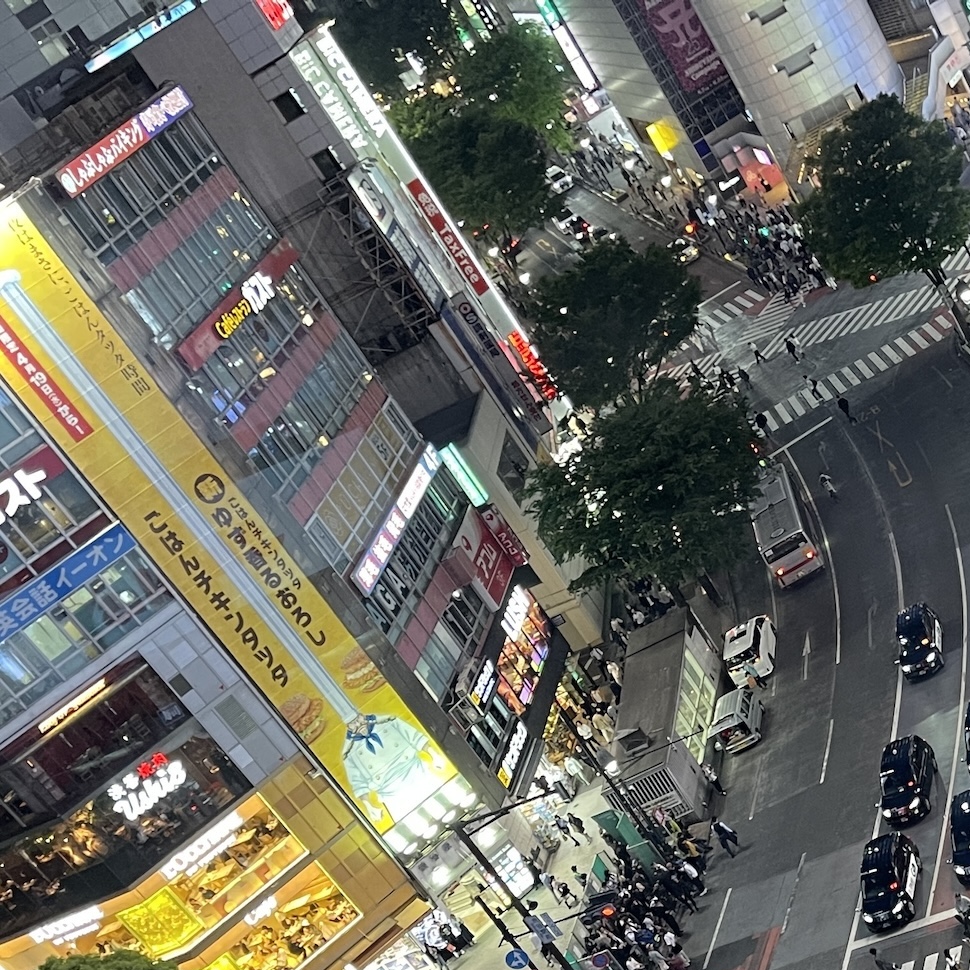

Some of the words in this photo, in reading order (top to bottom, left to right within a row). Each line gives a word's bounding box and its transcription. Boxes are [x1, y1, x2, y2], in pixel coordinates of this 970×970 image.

[0, 469, 47, 525] スト
[211, 507, 326, 647] ゆず香るおろし
[476, 543, 497, 579] アコム
[144, 510, 289, 688] ごはんチキンタツタ
[366, 565, 409, 635] AGA
[501, 585, 530, 642] LUSH
